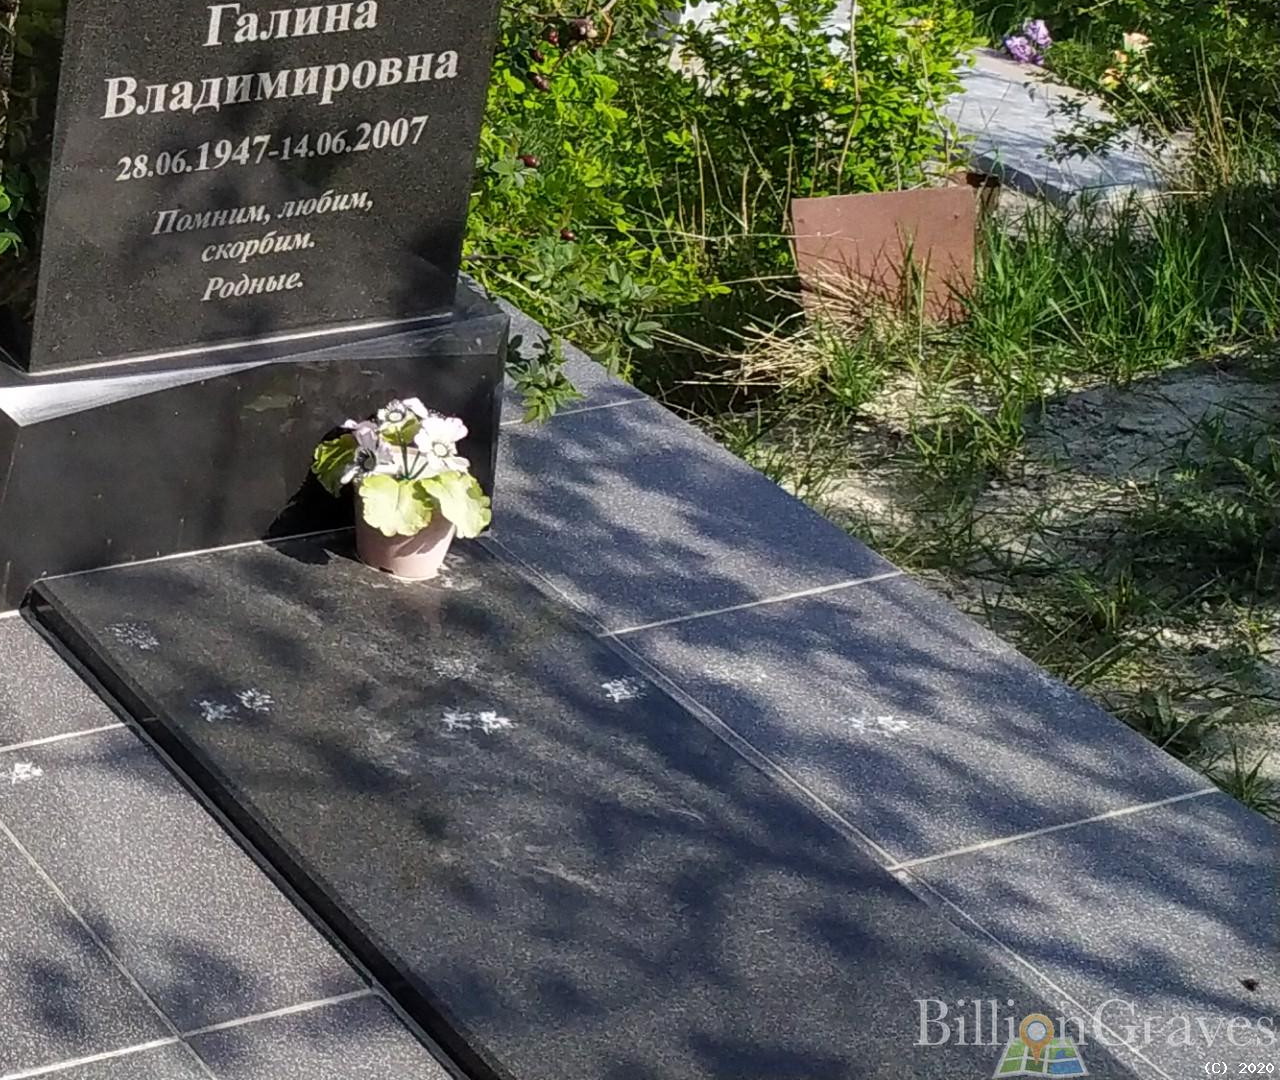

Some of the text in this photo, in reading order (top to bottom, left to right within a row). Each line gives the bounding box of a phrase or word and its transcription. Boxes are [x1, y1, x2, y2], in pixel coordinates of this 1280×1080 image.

[202, 0, 379, 46] Галина
[100, 50, 459, 120] Владимировна
[115, 116, 429, 181] 28.06.1947-14.06.2007
[151, 189, 374, 235] Помним, любим,
[201, 230, 315, 263] скорбим.
[200, 272, 304, 302] Родные.
